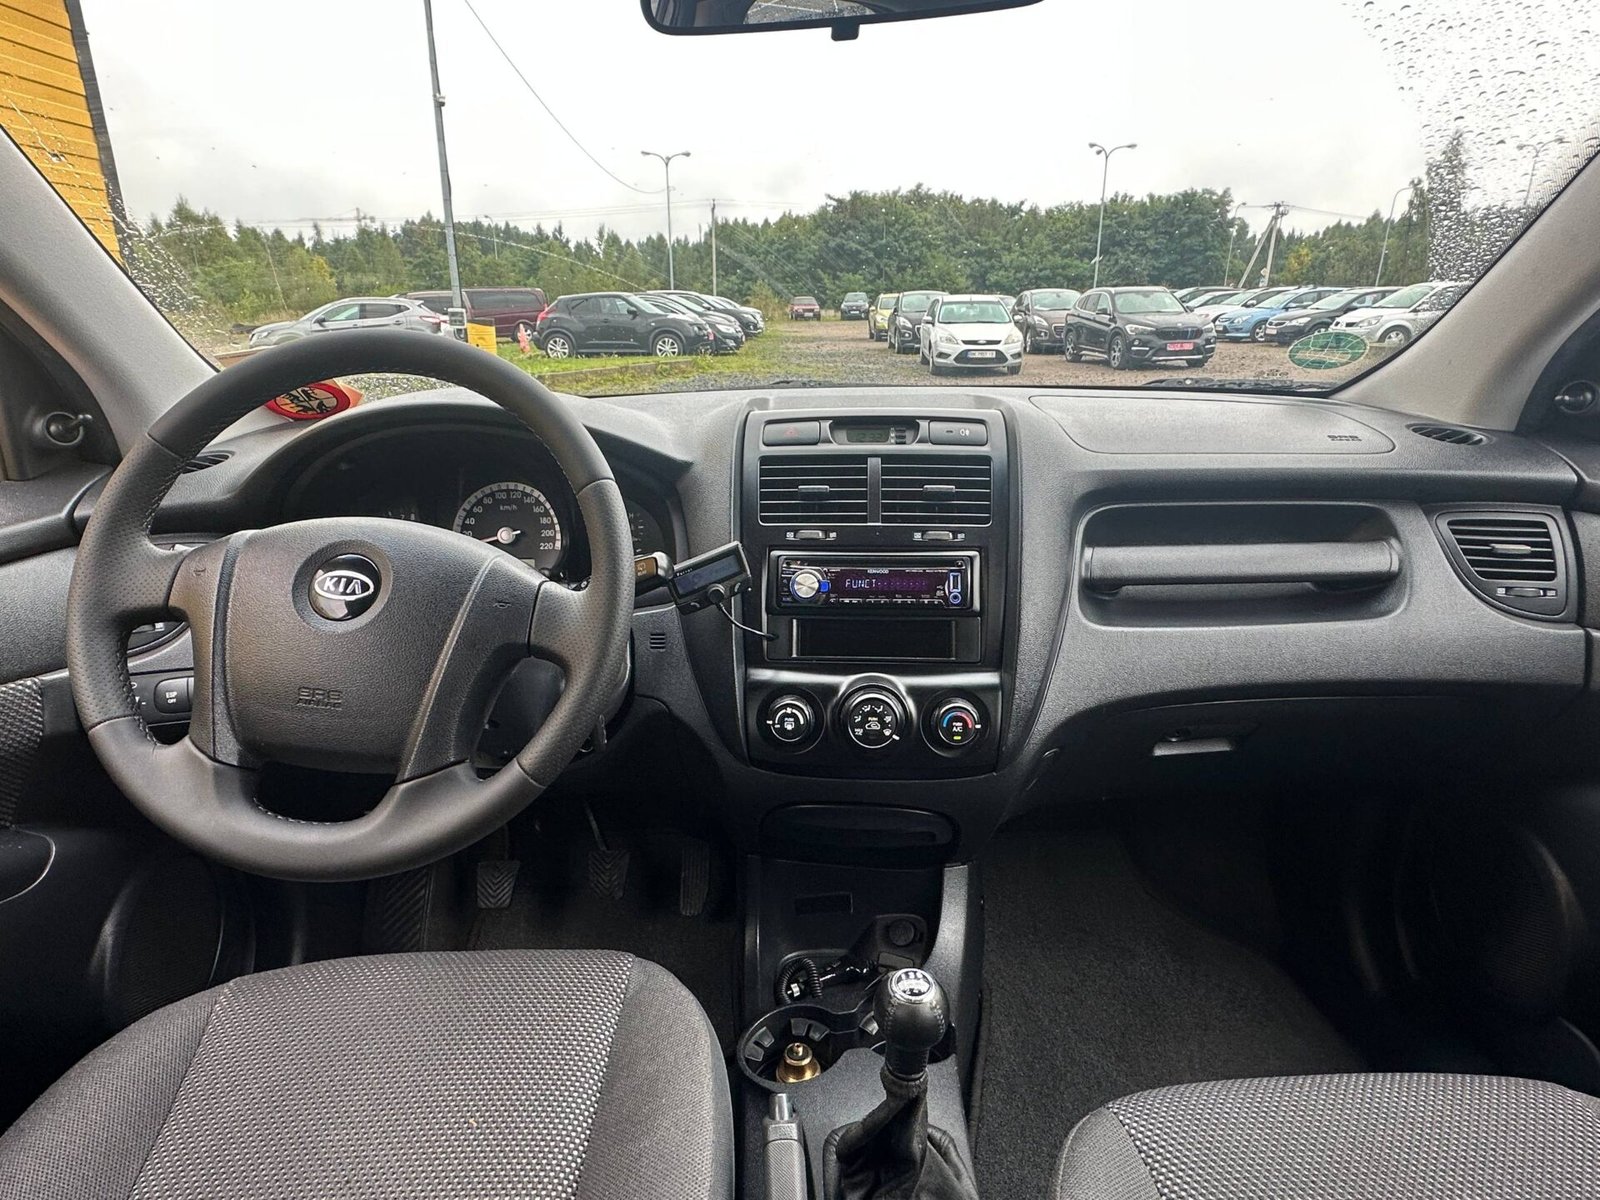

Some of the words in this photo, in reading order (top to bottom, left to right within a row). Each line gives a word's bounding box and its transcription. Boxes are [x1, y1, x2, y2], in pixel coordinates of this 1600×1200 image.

[495, 491, 507, 499] 100
[510, 491, 522, 499] 120
[483, 496, 493, 504] 80
[523, 496, 536, 504] 140
[473, 505, 483, 513] 60
[533, 505, 545, 513] 160
[465, 517, 475, 525] 40
[540, 516, 552, 525] 180
[541, 529, 555, 537] 200
[539, 542, 553, 550] 220
[323, 577, 362, 595] KIA
[165, 691, 178, 699] ESP
